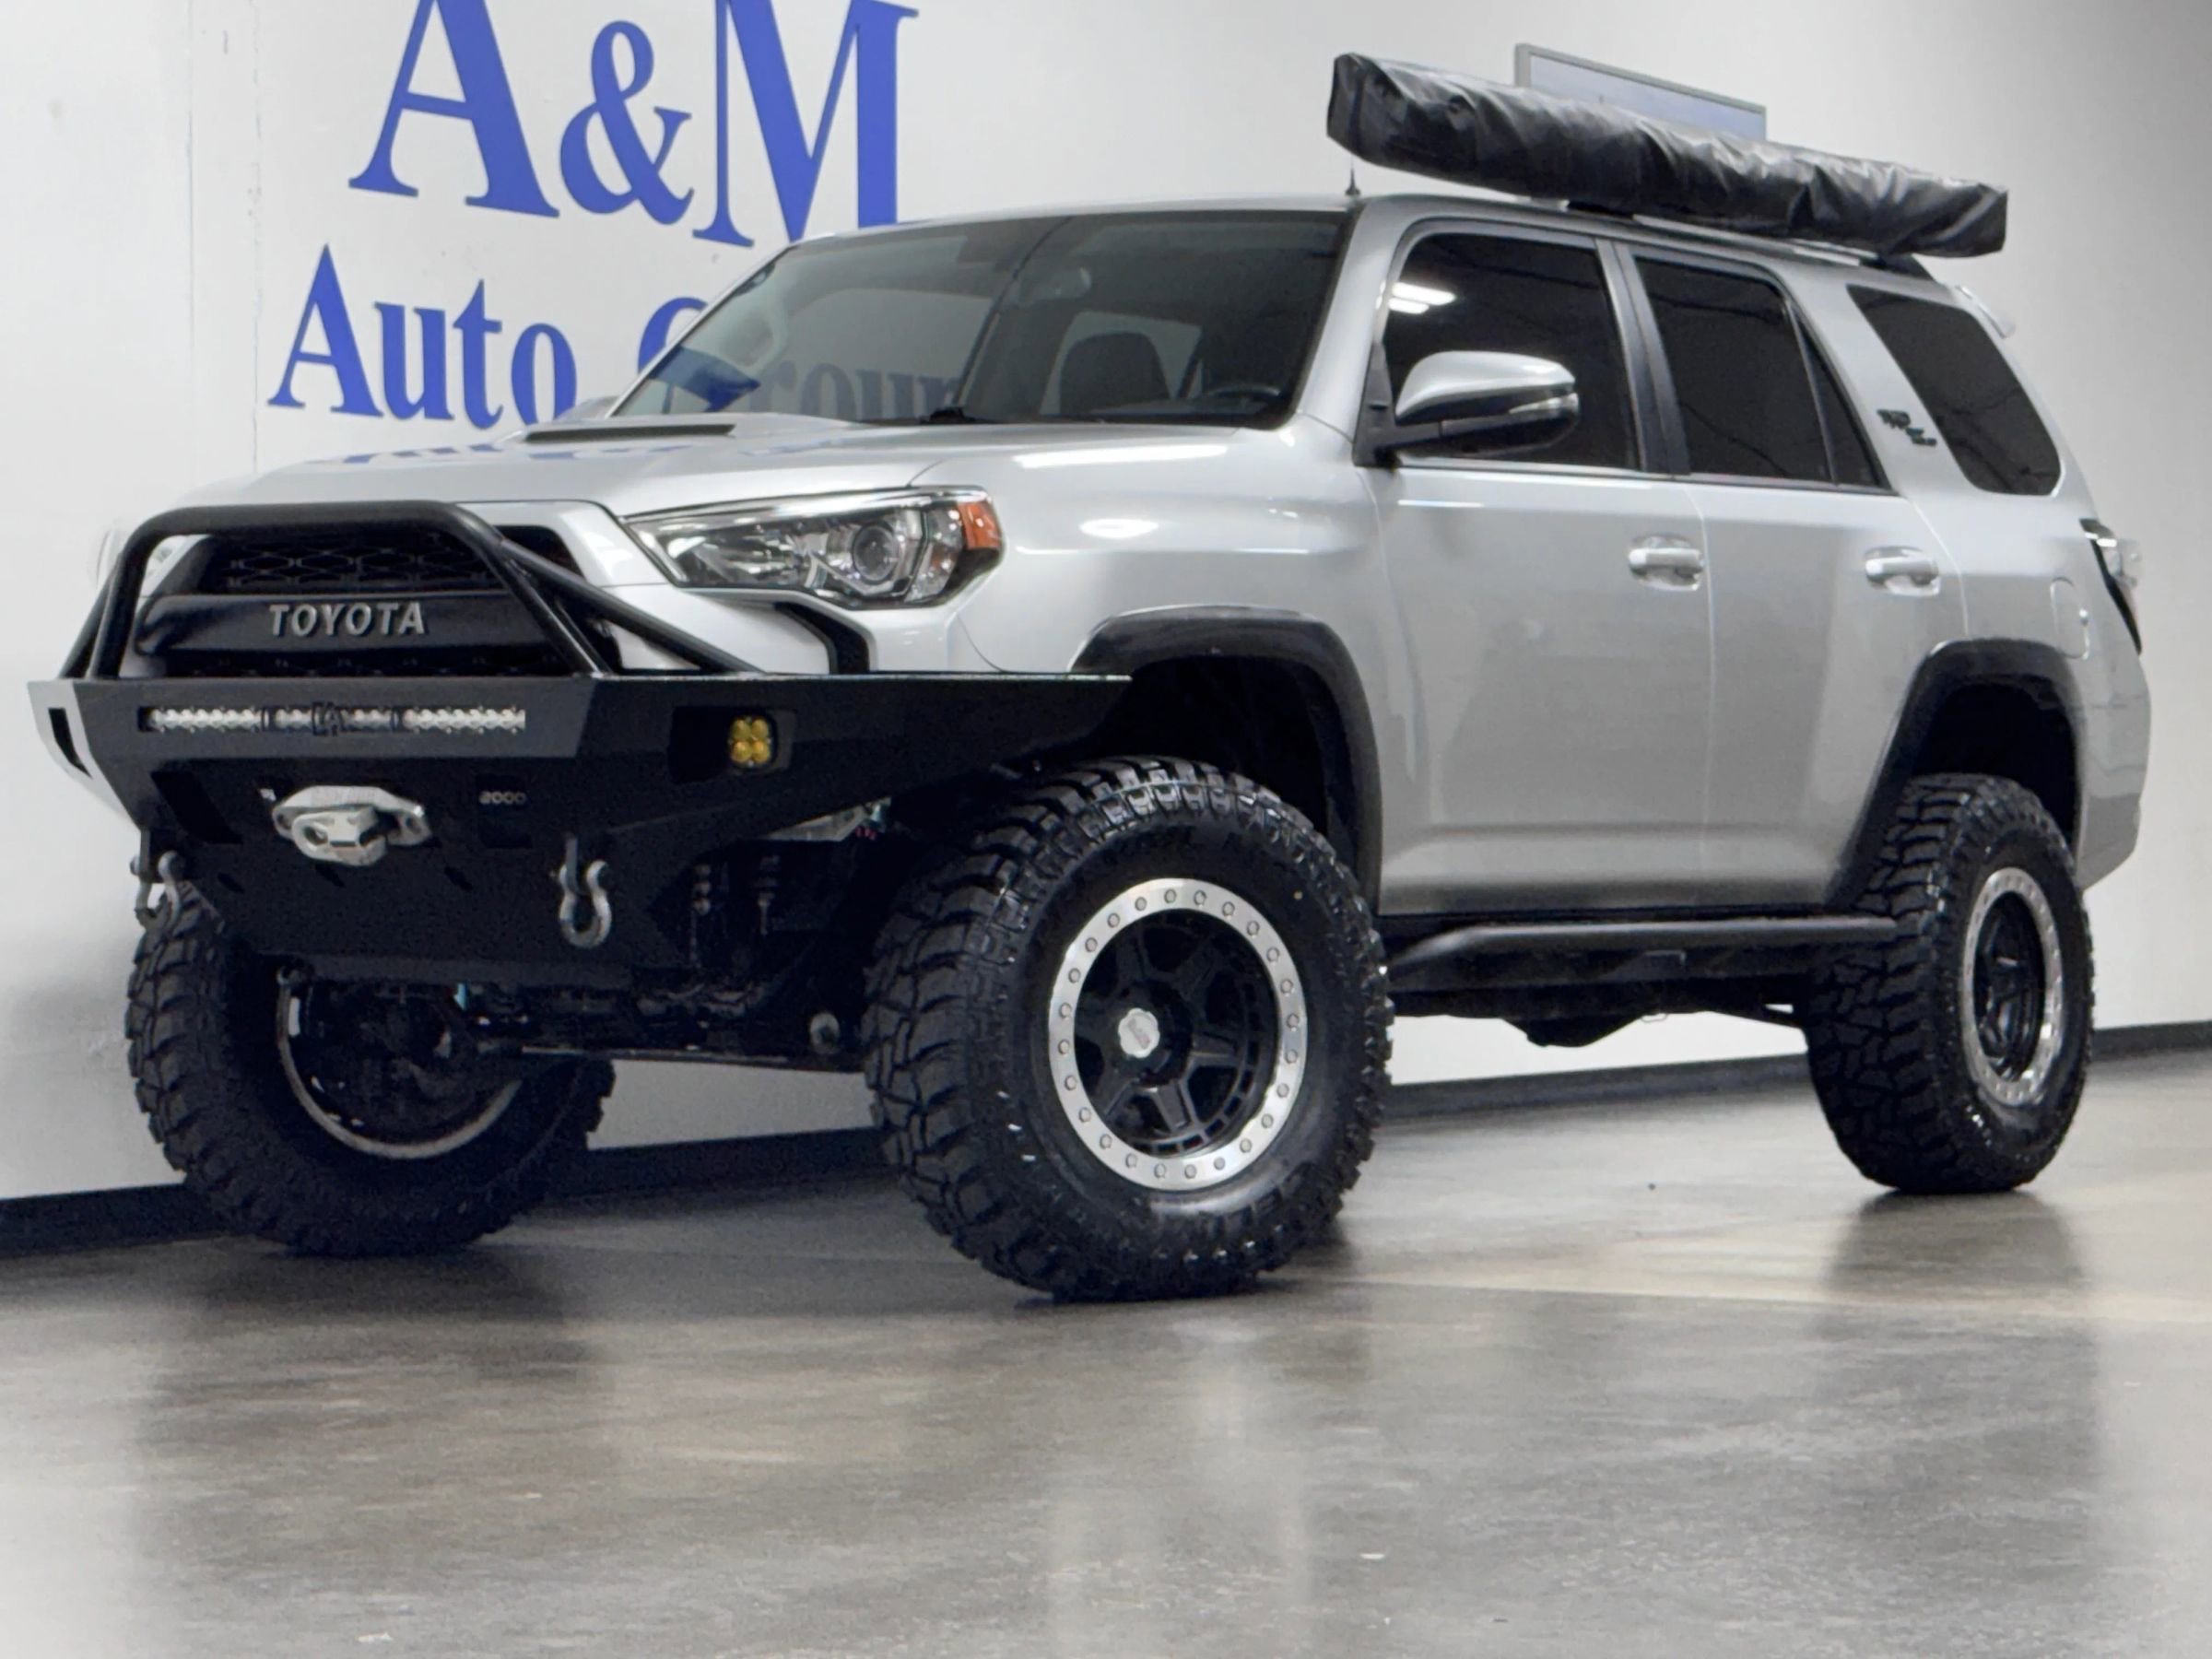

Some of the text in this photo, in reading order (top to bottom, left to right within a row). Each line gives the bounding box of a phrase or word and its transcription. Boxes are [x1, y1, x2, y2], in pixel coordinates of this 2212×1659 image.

[348, 0, 919, 248] A&M
[267, 243, 577, 429] Auto
[269, 601, 426, 637] TOYOTA
